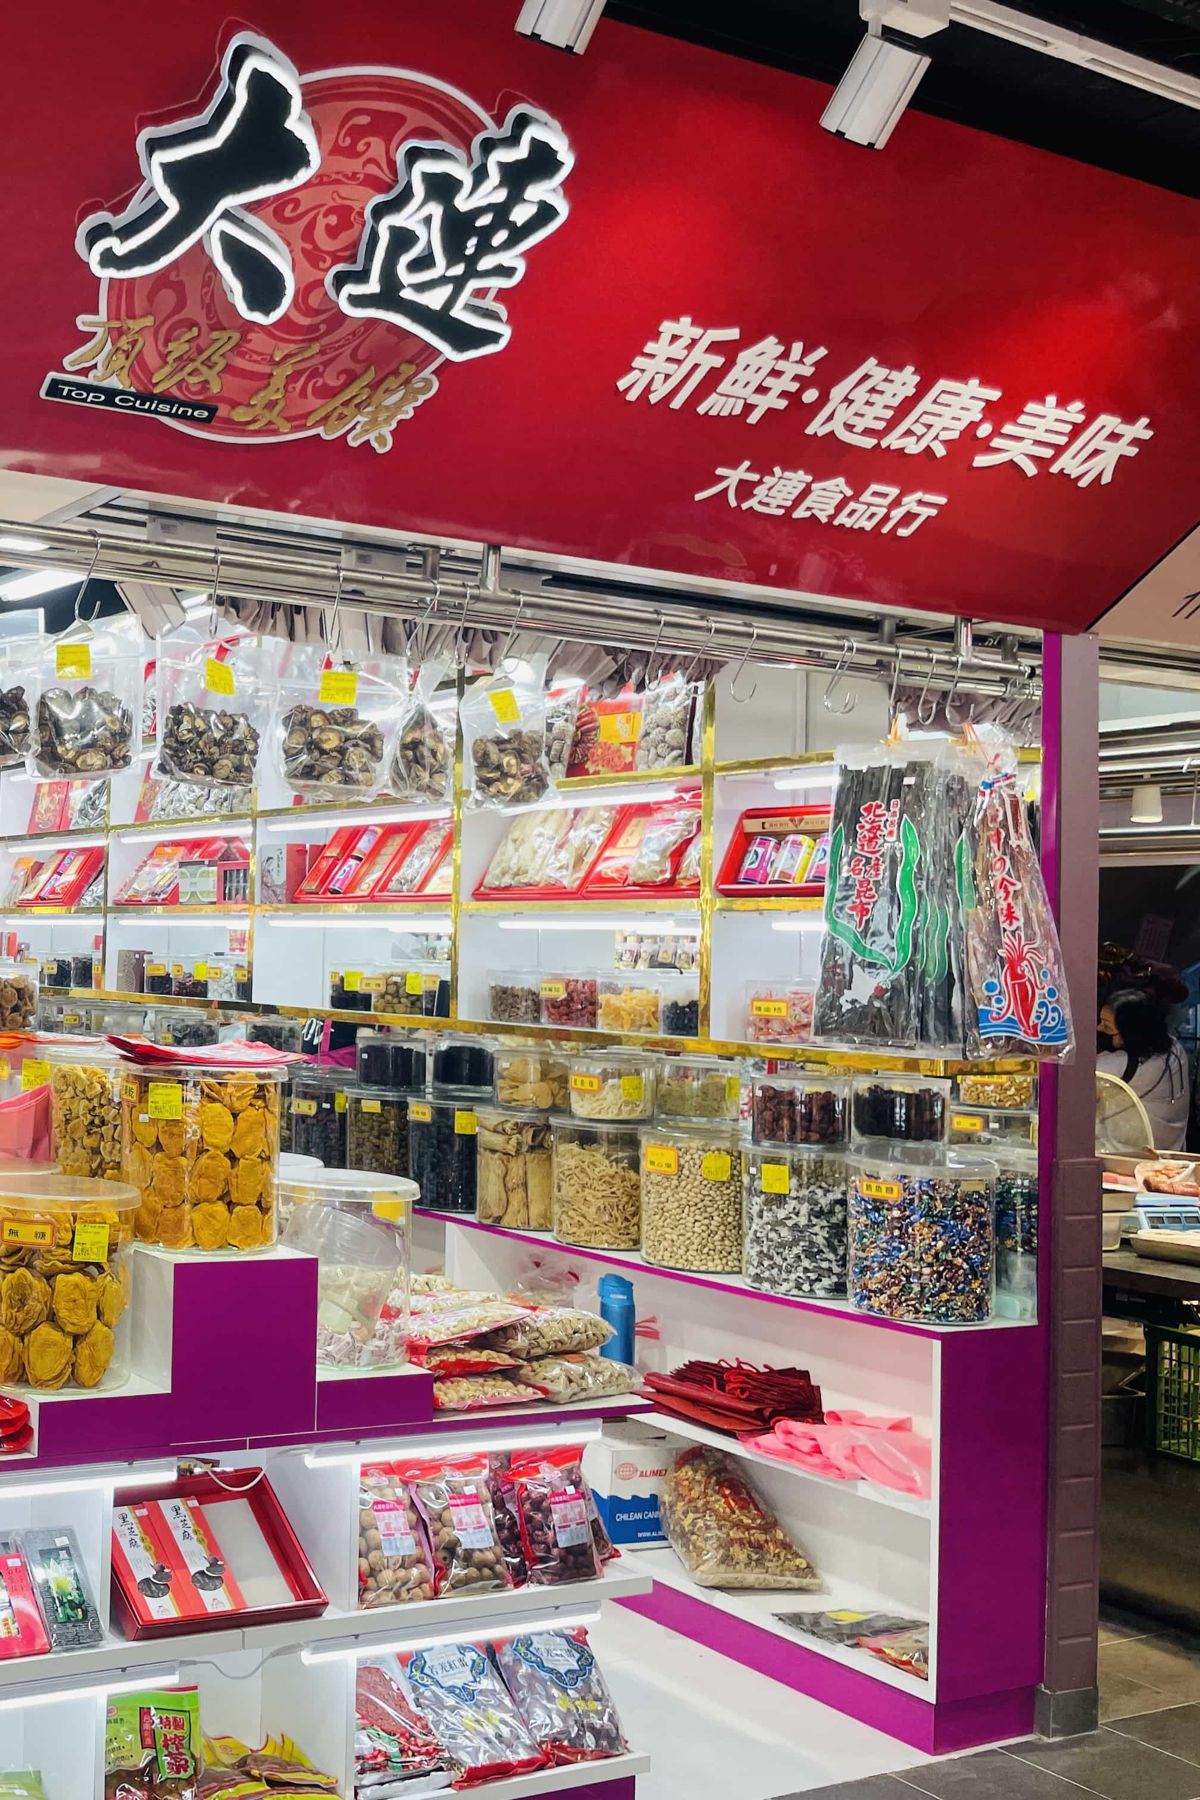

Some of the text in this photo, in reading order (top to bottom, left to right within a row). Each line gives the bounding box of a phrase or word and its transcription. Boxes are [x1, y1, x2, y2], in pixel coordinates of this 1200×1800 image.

[58, 384, 210, 419] Top Cuisine
[694, 460, 948, 537] 大連食品行
[615, 1511, 643, 1522] CHILEAN
